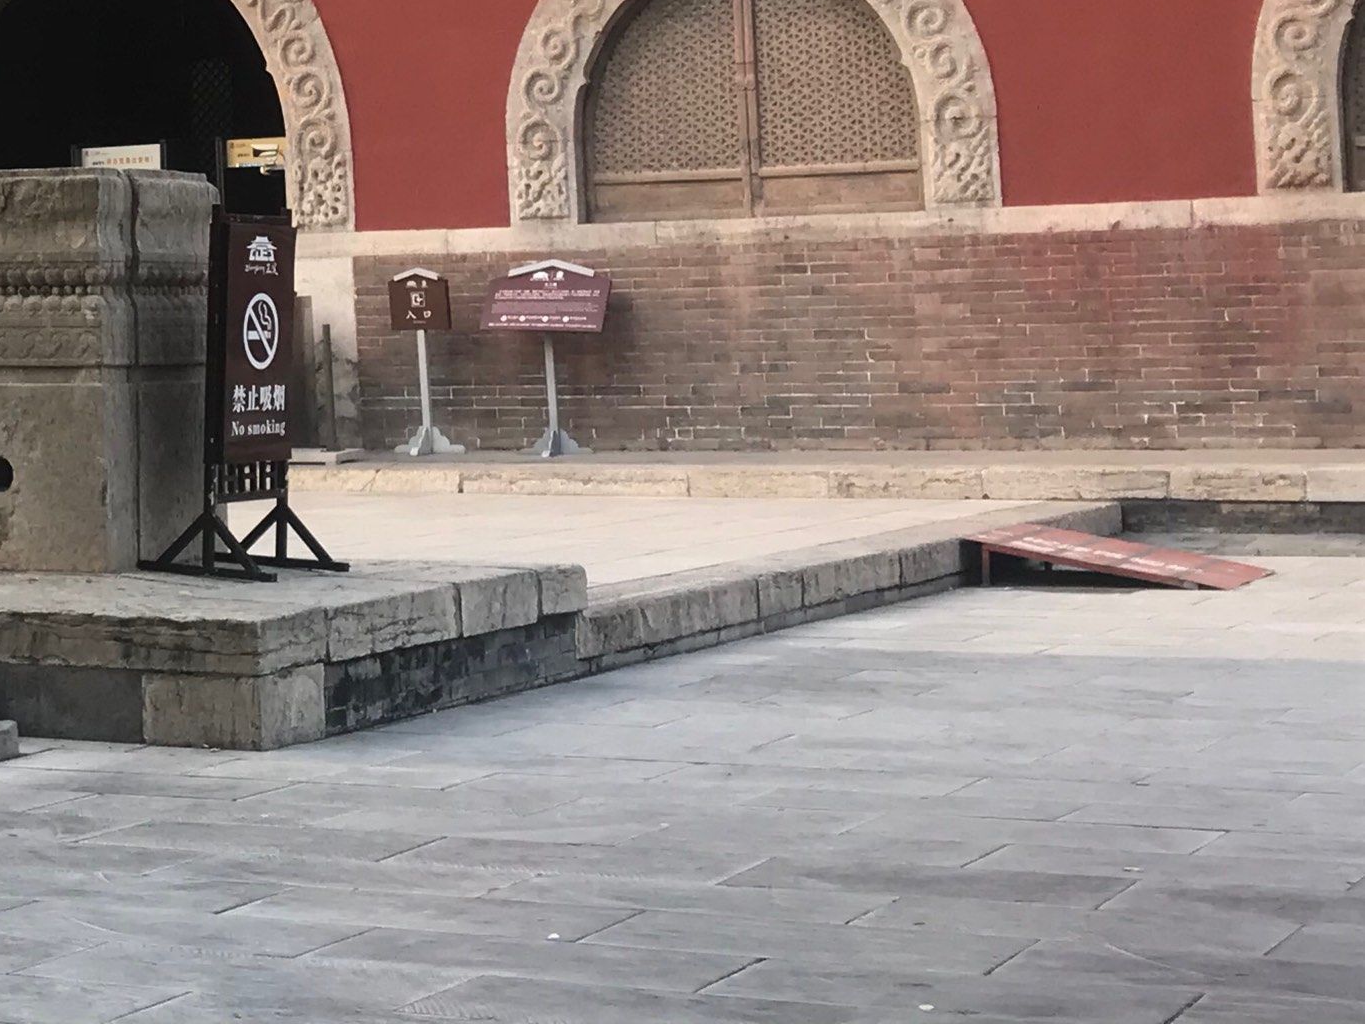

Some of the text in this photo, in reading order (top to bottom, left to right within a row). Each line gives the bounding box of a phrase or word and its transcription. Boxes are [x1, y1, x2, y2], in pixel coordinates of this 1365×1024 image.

[232, 384, 285, 413] 禁止吸烟
[231, 419, 285, 436] No smoking
